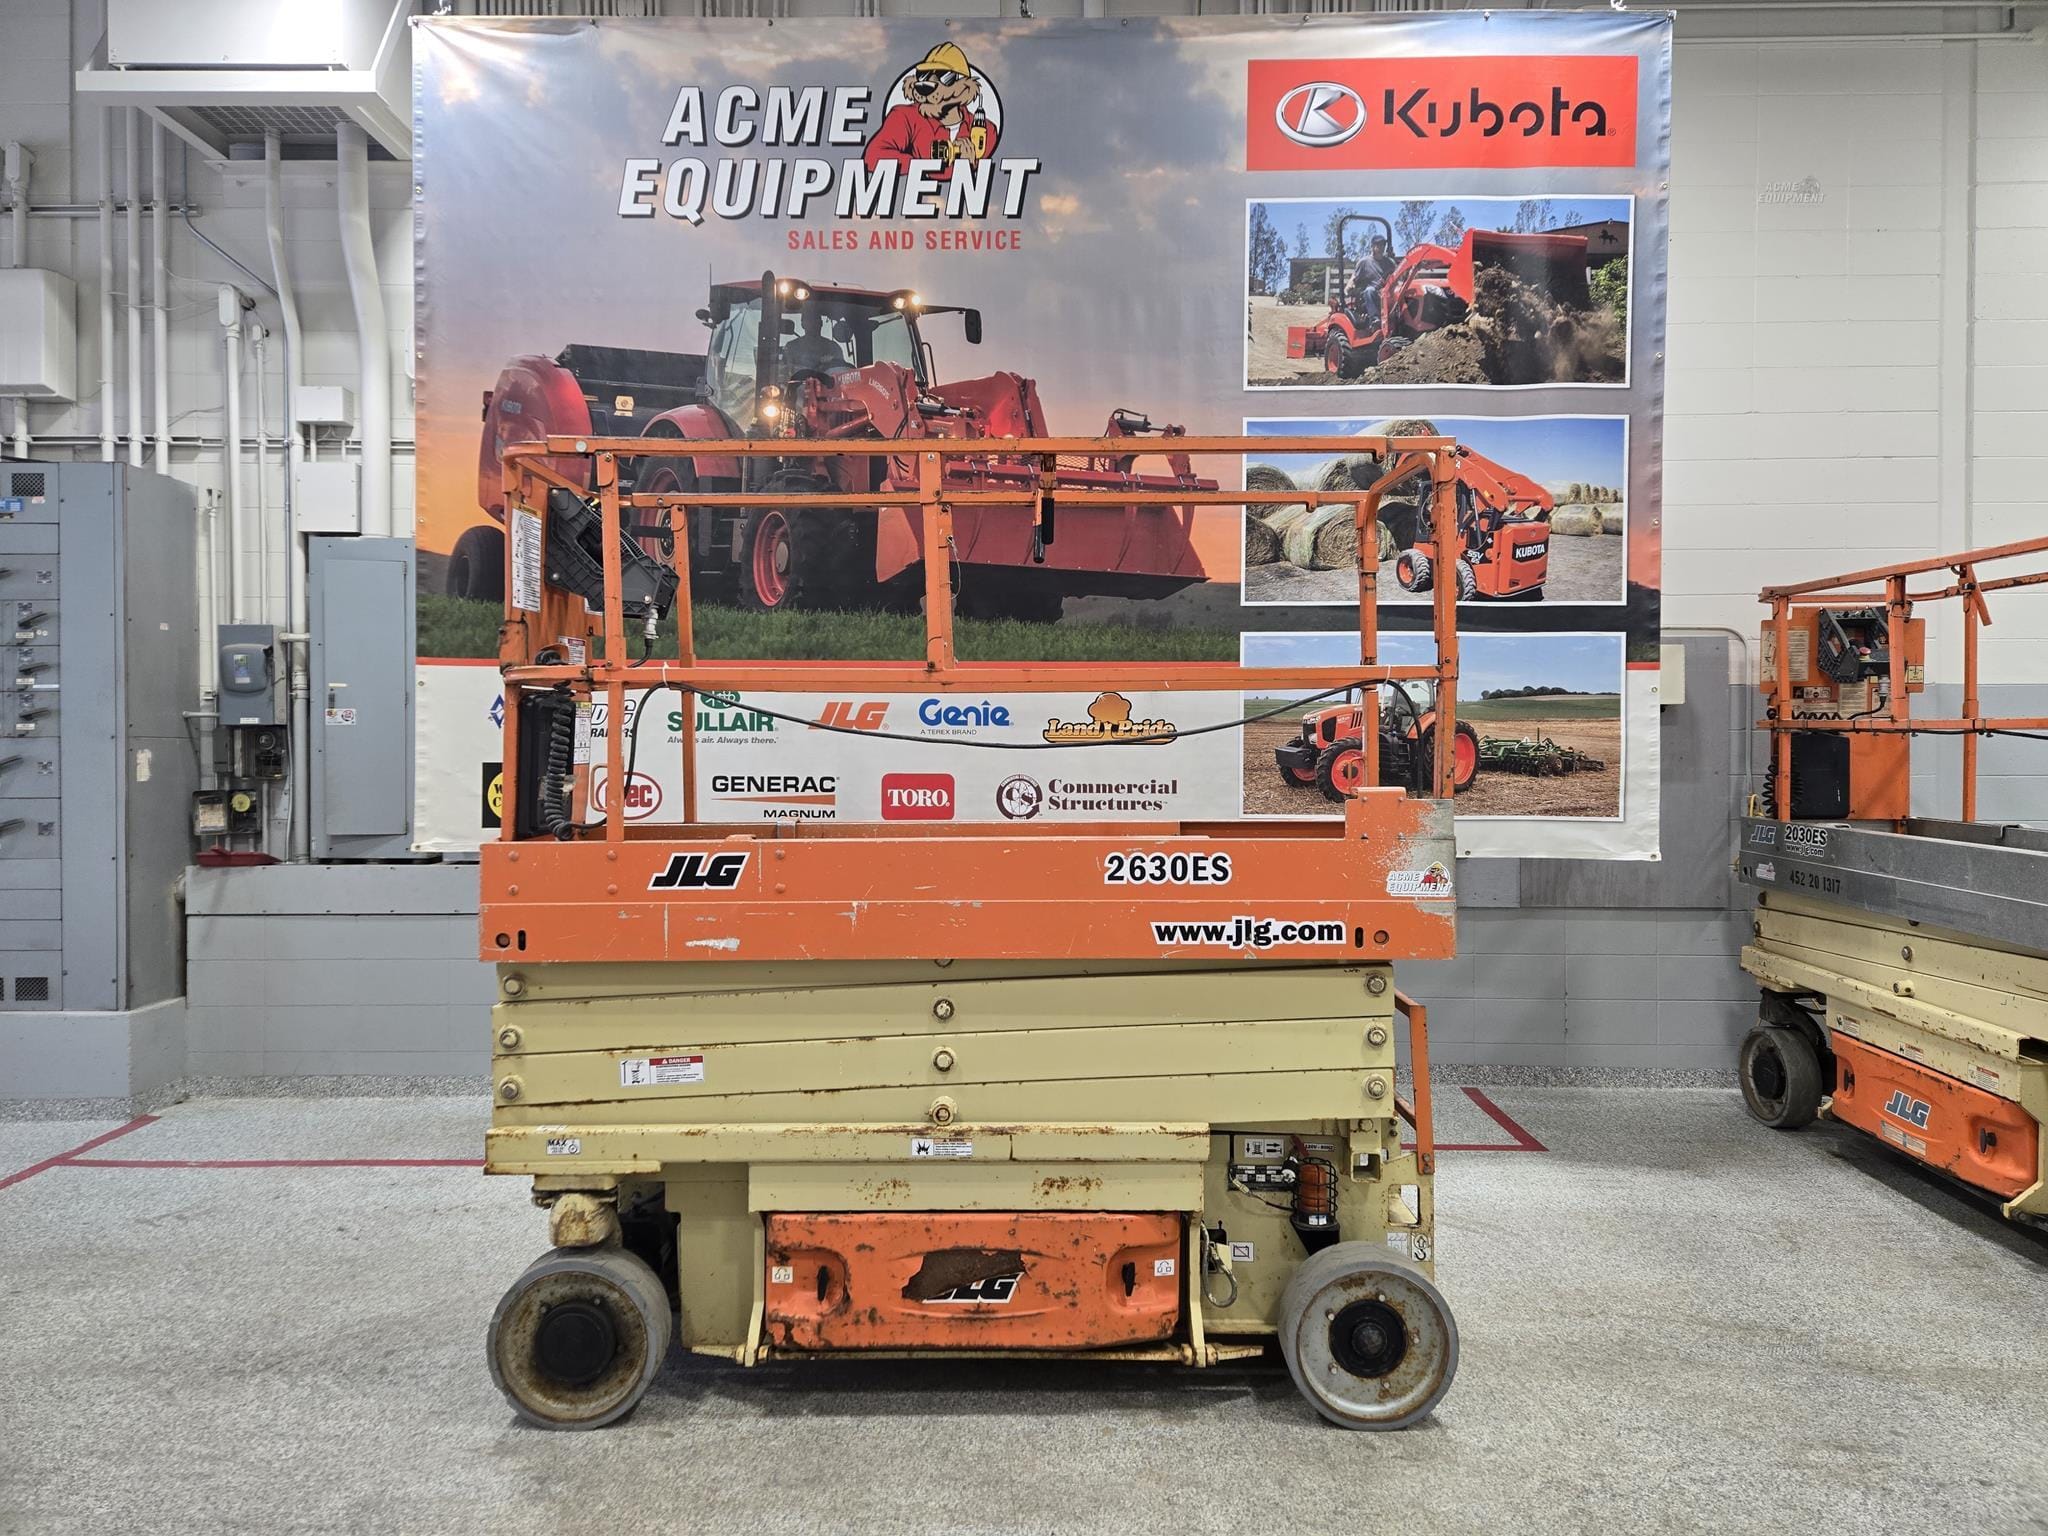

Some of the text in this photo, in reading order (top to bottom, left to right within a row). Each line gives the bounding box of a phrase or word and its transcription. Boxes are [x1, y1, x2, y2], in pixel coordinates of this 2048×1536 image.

[660, 85, 871, 147] ACME
[1384, 87, 1606, 138] Kubota
[617, 157, 1041, 225] EQUIPMENT
[788, 230, 1021, 250] SALES AND SERVICE
[1466, 549, 1484, 560] SSV
[1515, 543, 1545, 559] KUBOTA
[808, 702, 890, 730] JLG
[919, 699, 1010, 727] Genie
[1048, 719, 1176, 738] Land Pride
[701, 736, 714, 744] air.
[716, 736, 749, 745] Always
[751, 736, 777, 744] there.
[712, 775, 836, 793] GENERAC
[1048, 778, 1178, 795] Commercial
[887, 789, 946, 807] TORO
[1048, 796, 1163, 811] Structures
[763, 809, 836, 818] MAGNUM
[1751, 825, 1776, 844] JLG
[1784, 825, 1827, 846] 2030ES
[651, 854, 747, 887] JLG
[1106, 855, 1230, 882] 2630ES
[1389, 872, 1421, 881] ACME
[1388, 883, 1452, 892] EQUIPMENT
[1789, 870, 1806, 886] 452
[1808, 873, 1820, 889] 20
[1823, 876, 1841, 894] 1317
[1154, 918, 1344, 946] www.jlg.com
[1885, 1090, 1931, 1130] JLG
